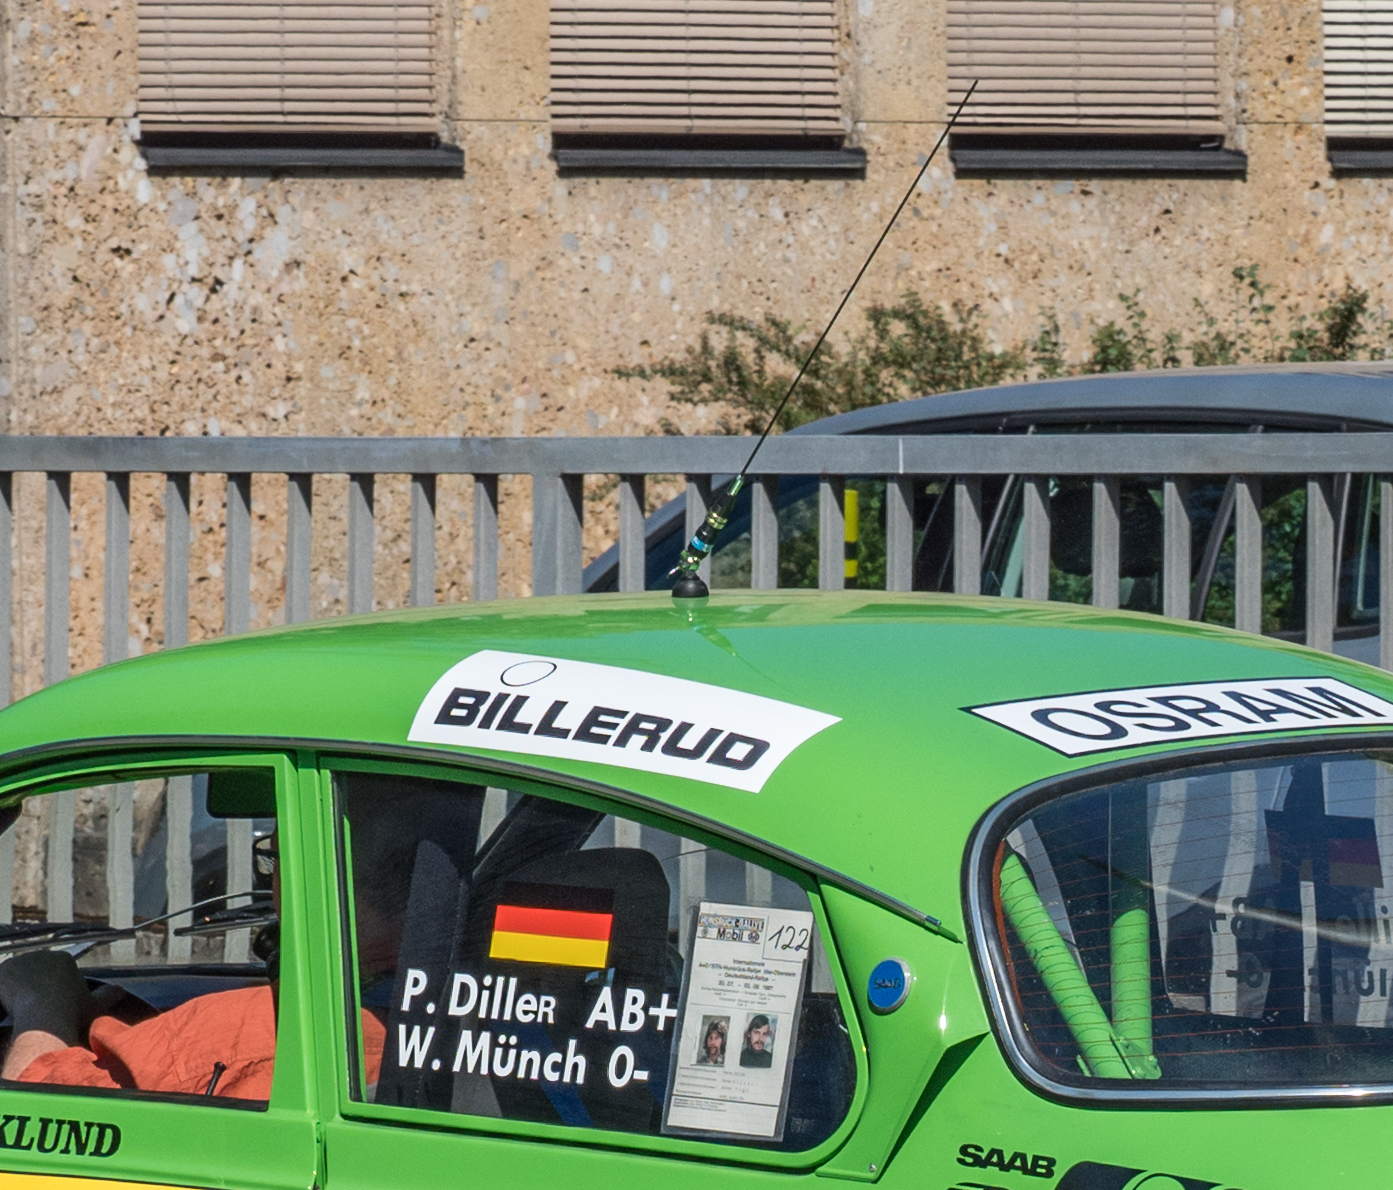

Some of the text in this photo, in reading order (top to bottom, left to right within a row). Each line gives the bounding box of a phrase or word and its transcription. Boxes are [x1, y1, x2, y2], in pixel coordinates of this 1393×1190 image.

[433, 685, 771, 771] BILLERUD
[1030, 685, 1388, 741] OSRAM
[768, 924, 809, 952] 122
[400, 968, 435, 1014] P.
[586, 986, 678, 1032] AB+
[397, 1023, 442, 1072] W.
[452, 1030, 587, 1085] Münch
[956, 1143, 1057, 1179] SAAB
